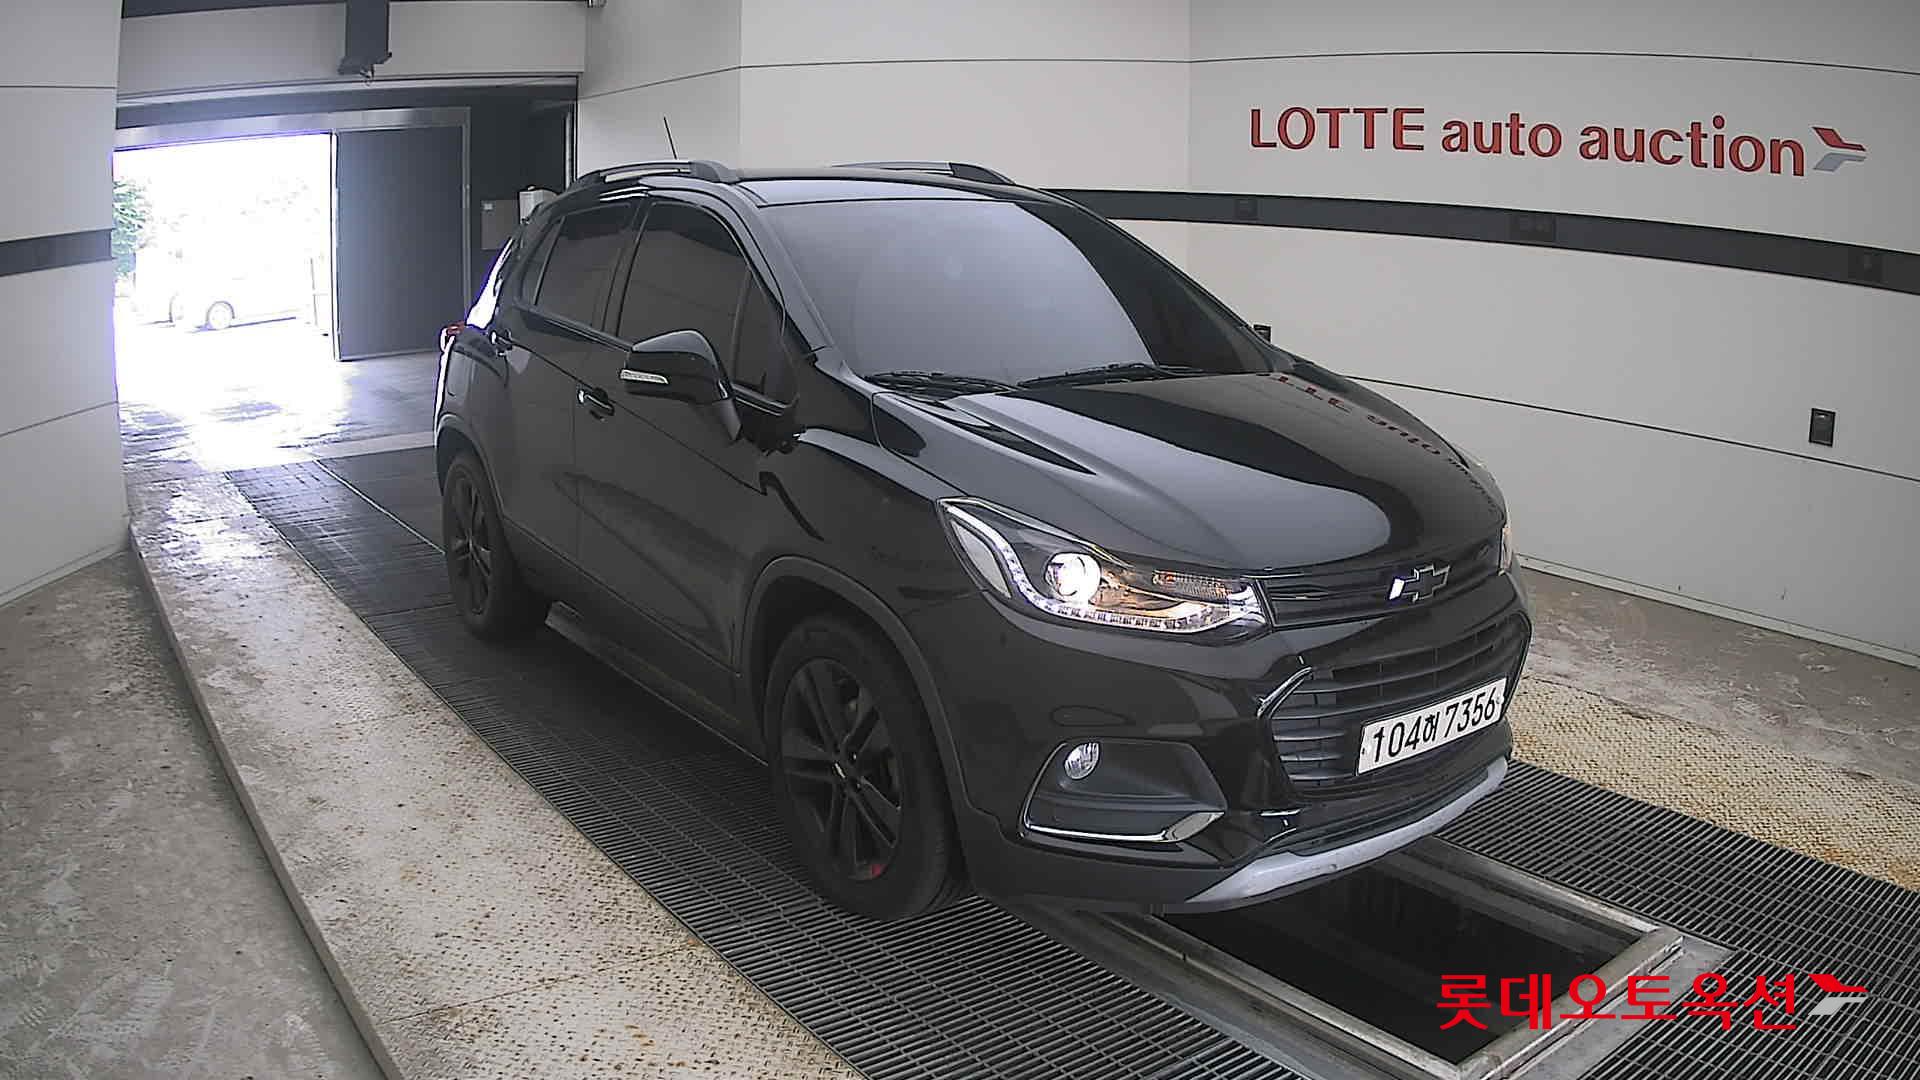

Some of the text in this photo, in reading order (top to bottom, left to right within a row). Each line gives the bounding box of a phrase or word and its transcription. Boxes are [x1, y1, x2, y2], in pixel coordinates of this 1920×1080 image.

[1250, 106, 1805, 177] LOTTE auto auction
[1373, 687, 1498, 763] 104허 7356
